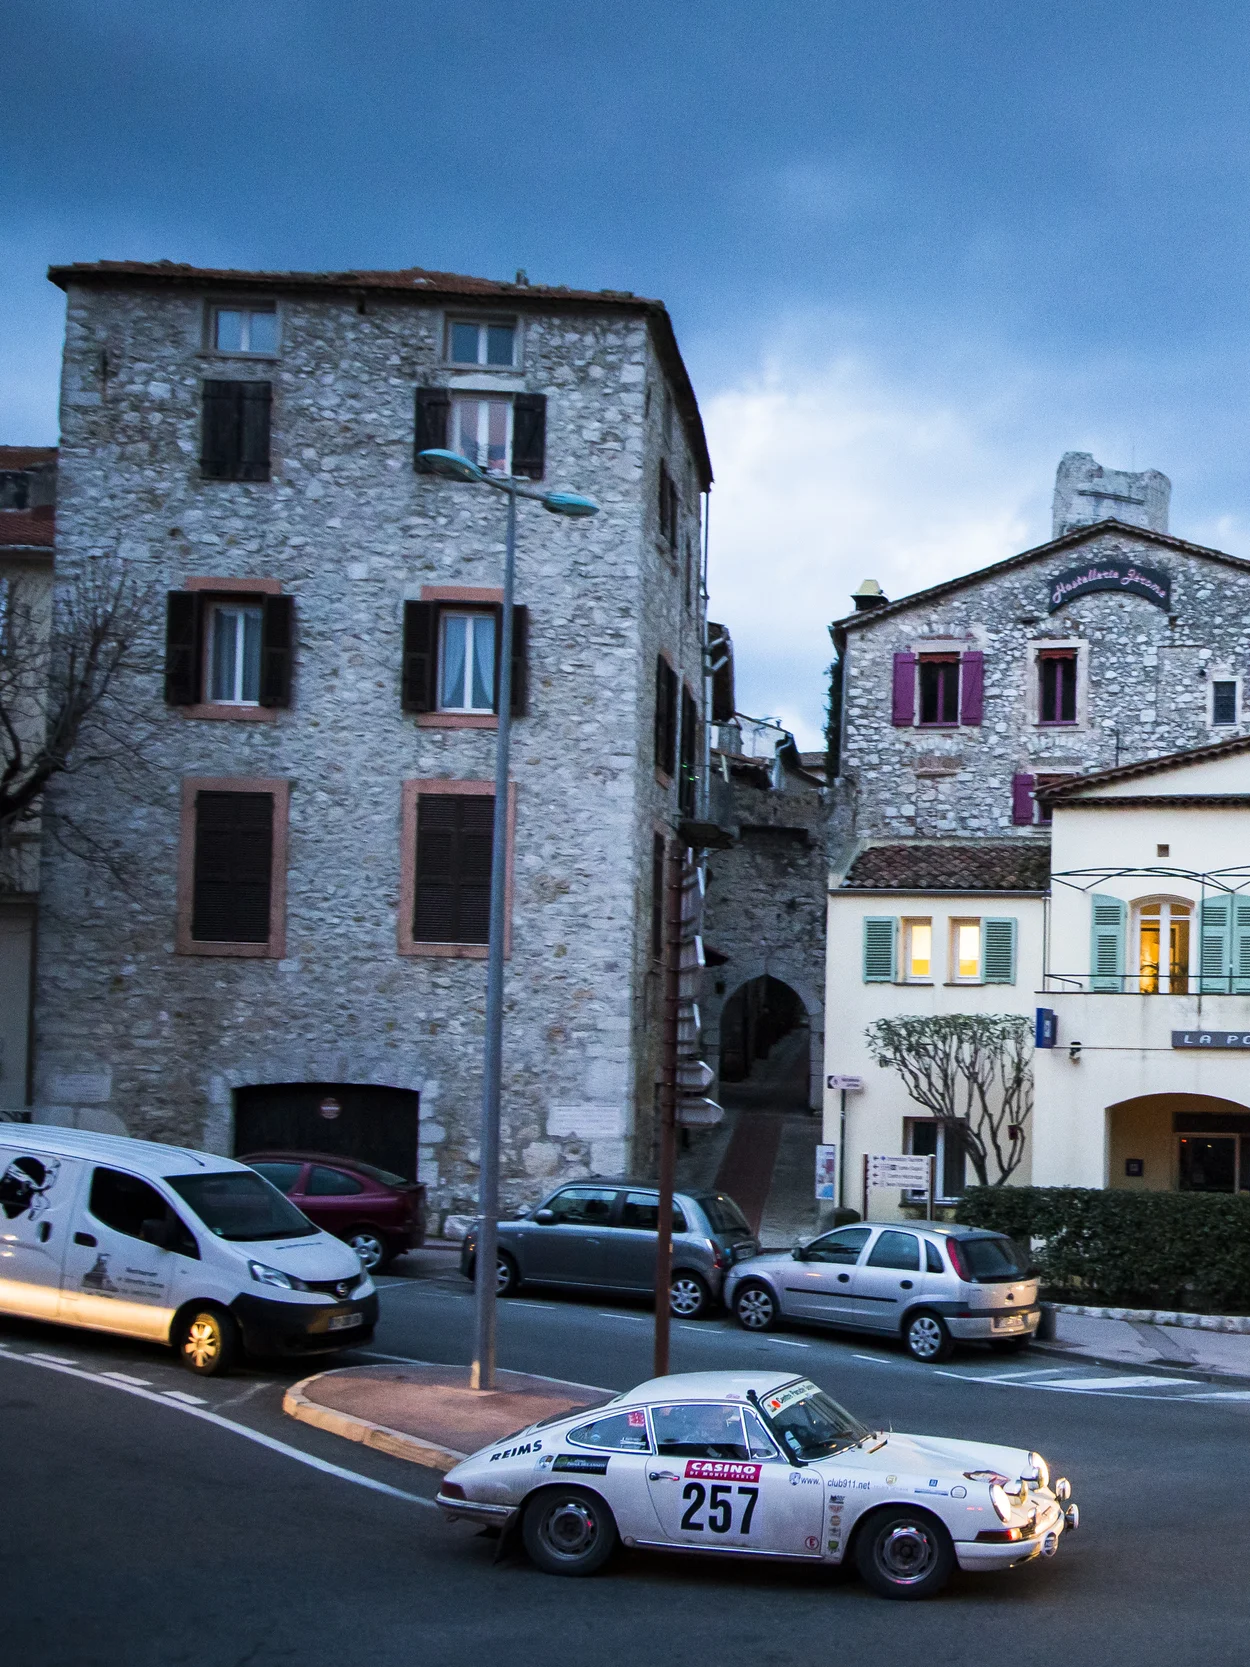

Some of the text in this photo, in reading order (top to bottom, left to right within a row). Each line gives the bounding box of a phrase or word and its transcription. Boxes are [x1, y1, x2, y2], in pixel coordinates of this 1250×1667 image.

[1184, 1034, 1211, 1044] LA
[490, 1440, 542, 1462] REIMS
[691, 1462, 756, 1475] CASINO
[801, 1477, 820, 1486] www.
[827, 1478, 871, 1490] club911.net
[680, 1481, 759, 1535] 257
